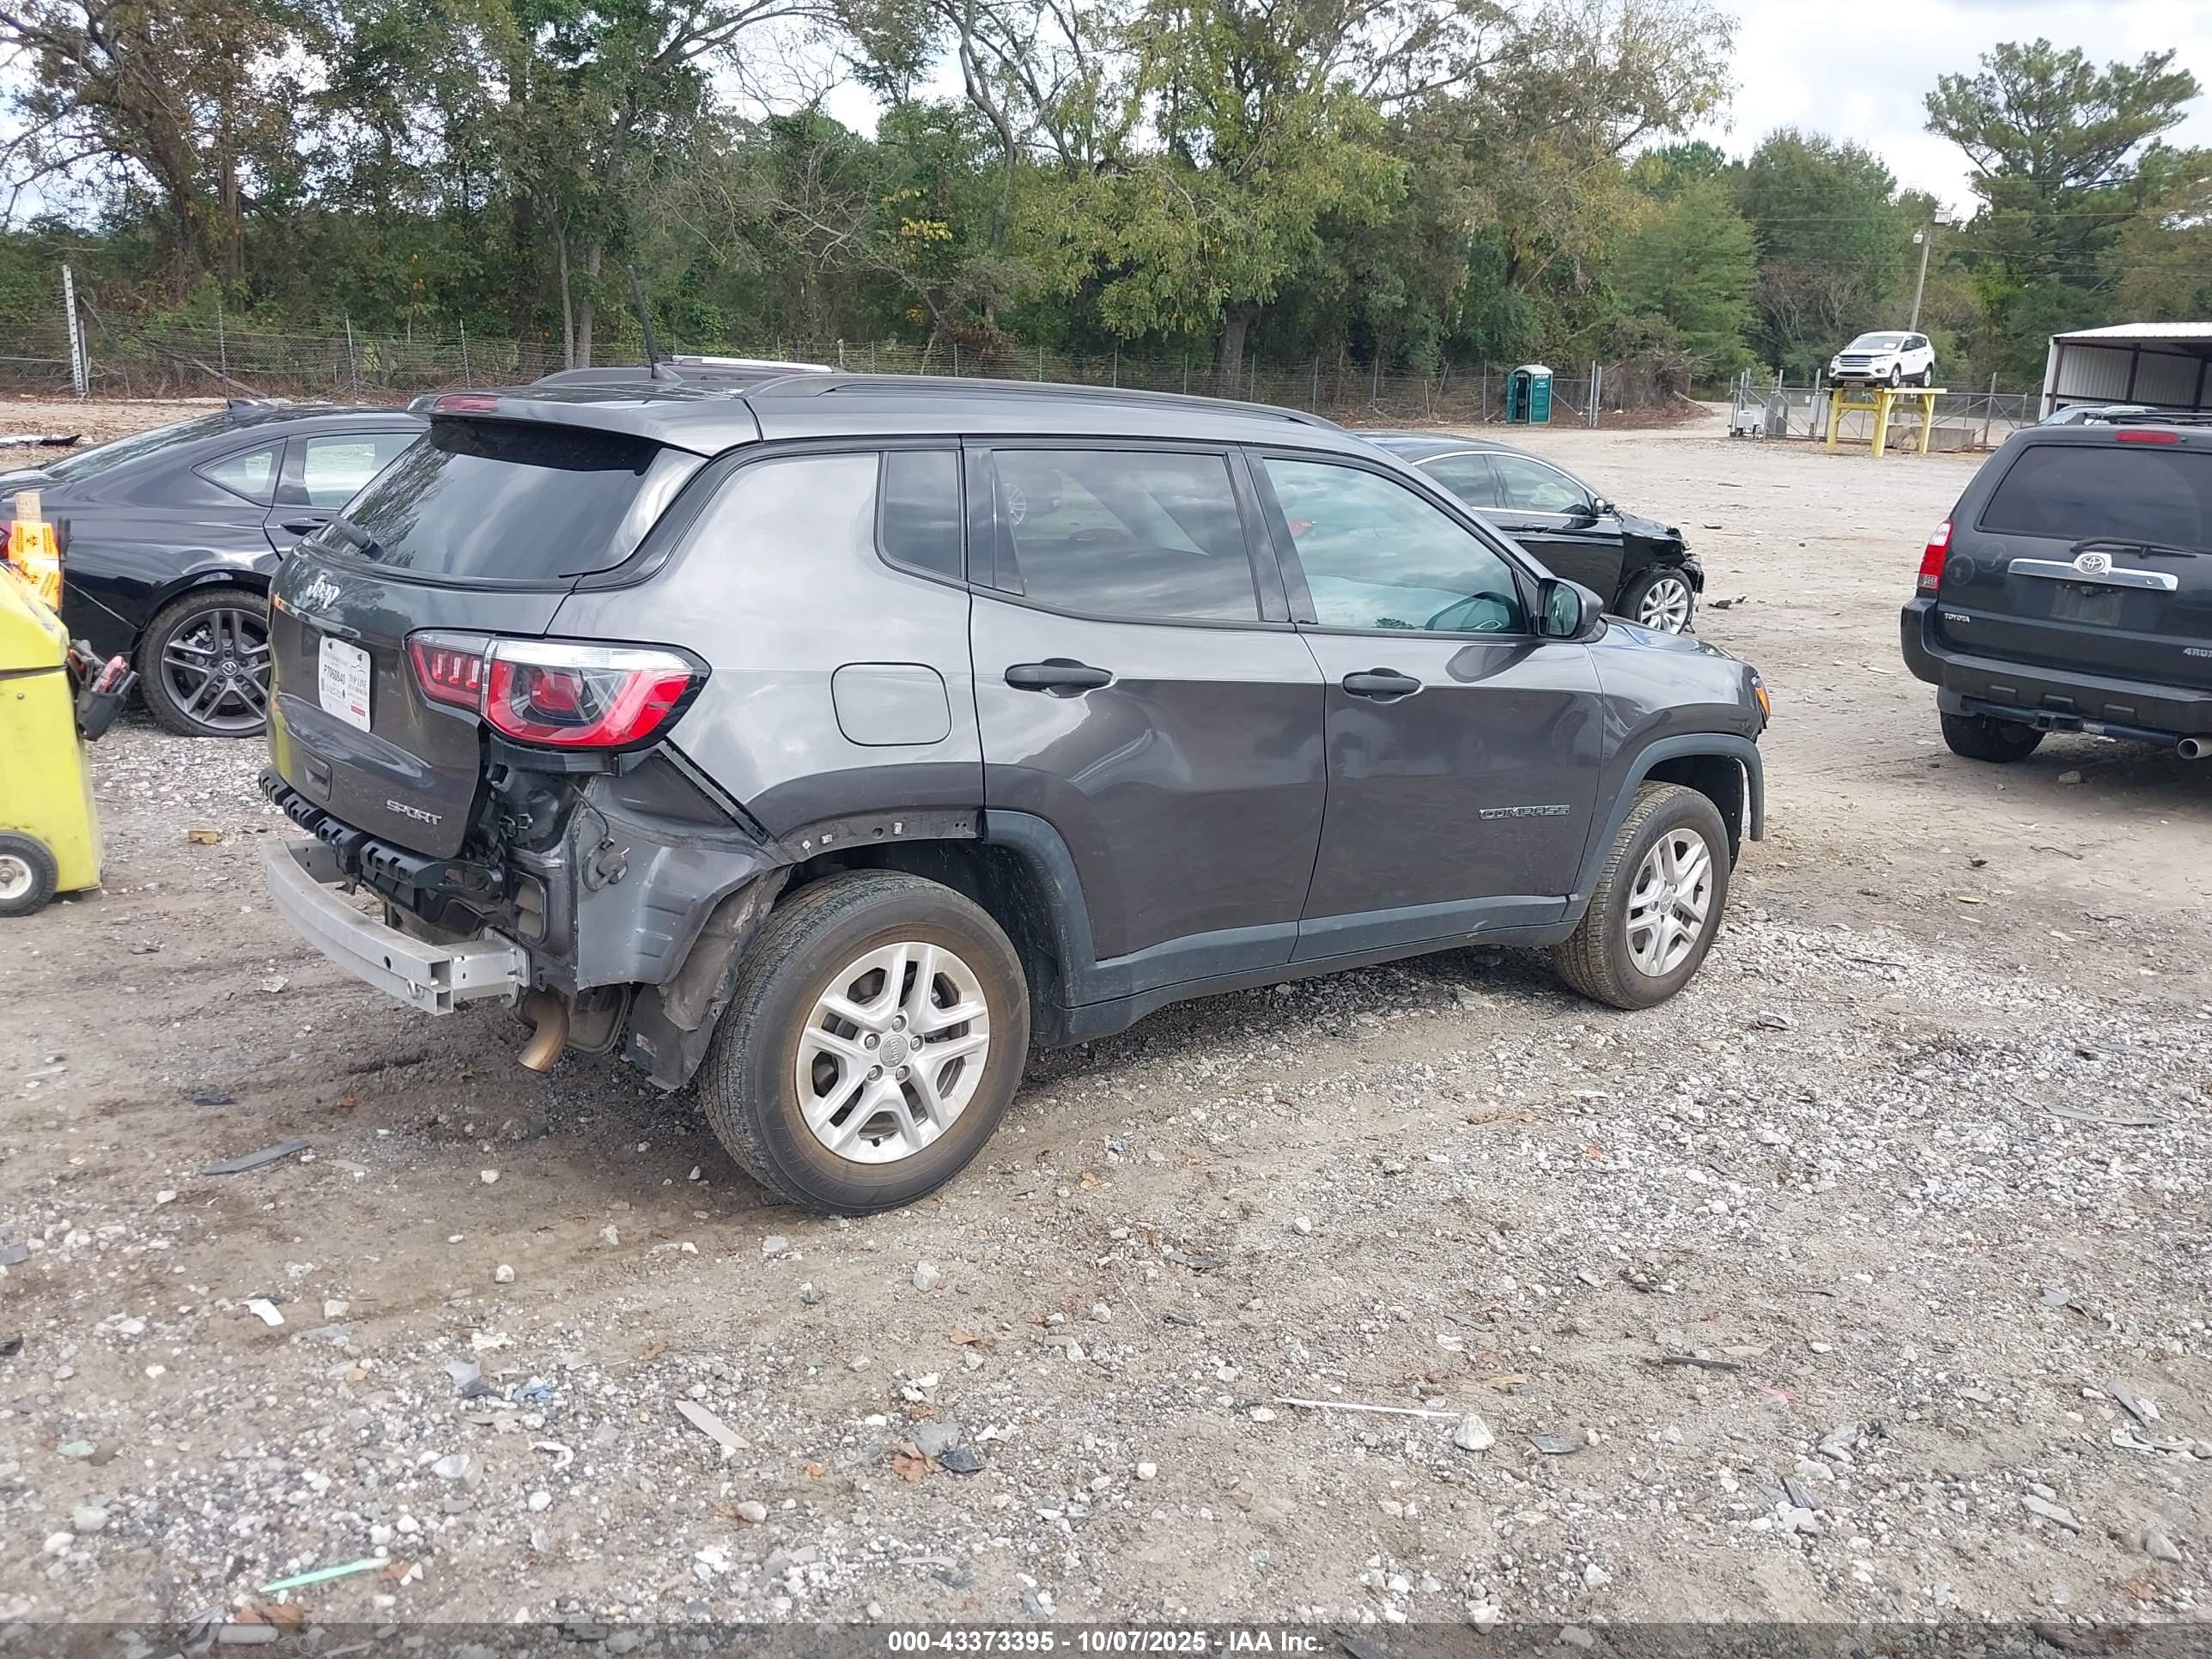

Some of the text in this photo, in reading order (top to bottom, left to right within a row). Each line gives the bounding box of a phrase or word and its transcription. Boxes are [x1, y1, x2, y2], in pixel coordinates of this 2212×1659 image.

[307, 574, 340, 609] Jeep
[1944, 612, 1970, 623] TOYOTA
[386, 799, 442, 824] SPORT
[1479, 805, 1571, 820] COMPASS
